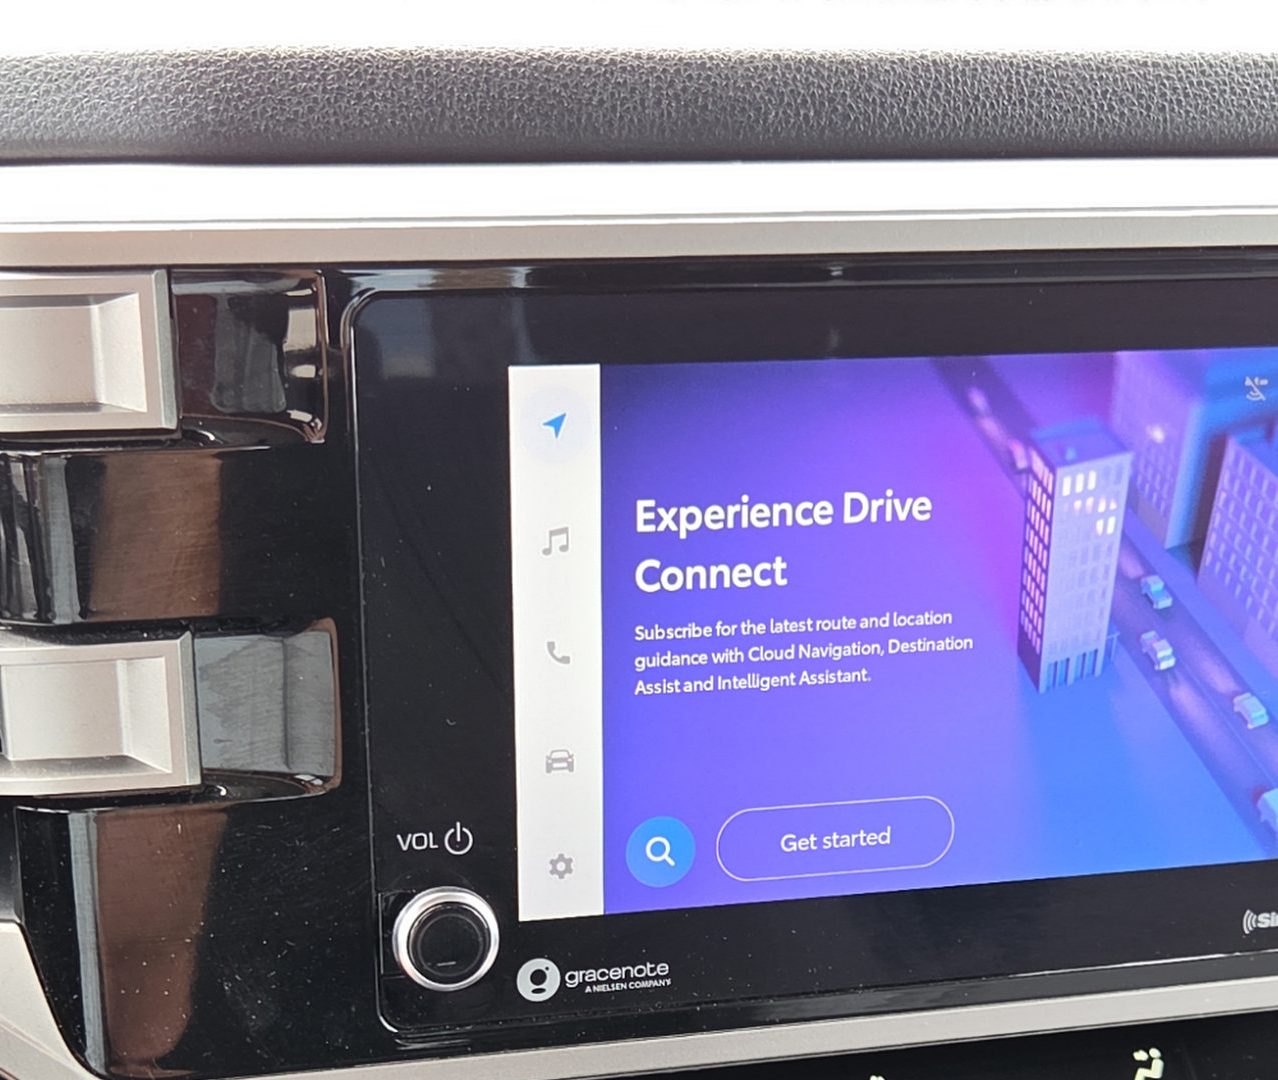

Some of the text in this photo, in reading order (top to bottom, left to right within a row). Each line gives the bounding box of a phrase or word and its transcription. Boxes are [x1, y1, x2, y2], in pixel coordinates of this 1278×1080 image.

[635, 488, 933, 540] Experience Drive
[634, 555, 789, 593] Connect
[634, 609, 953, 641] Subscribe for the latest route and location
[634, 635, 974, 673] guidance with Cloud Navigation, Destination
[633, 667, 872, 696] Assist and Intelligent Assistant.
[396, 831, 439, 851] VOL
[780, 825, 892, 853] Get started
[564, 961, 670, 988] gracenote
[584, 978, 672, 994] A NIELSEN COMPANY
